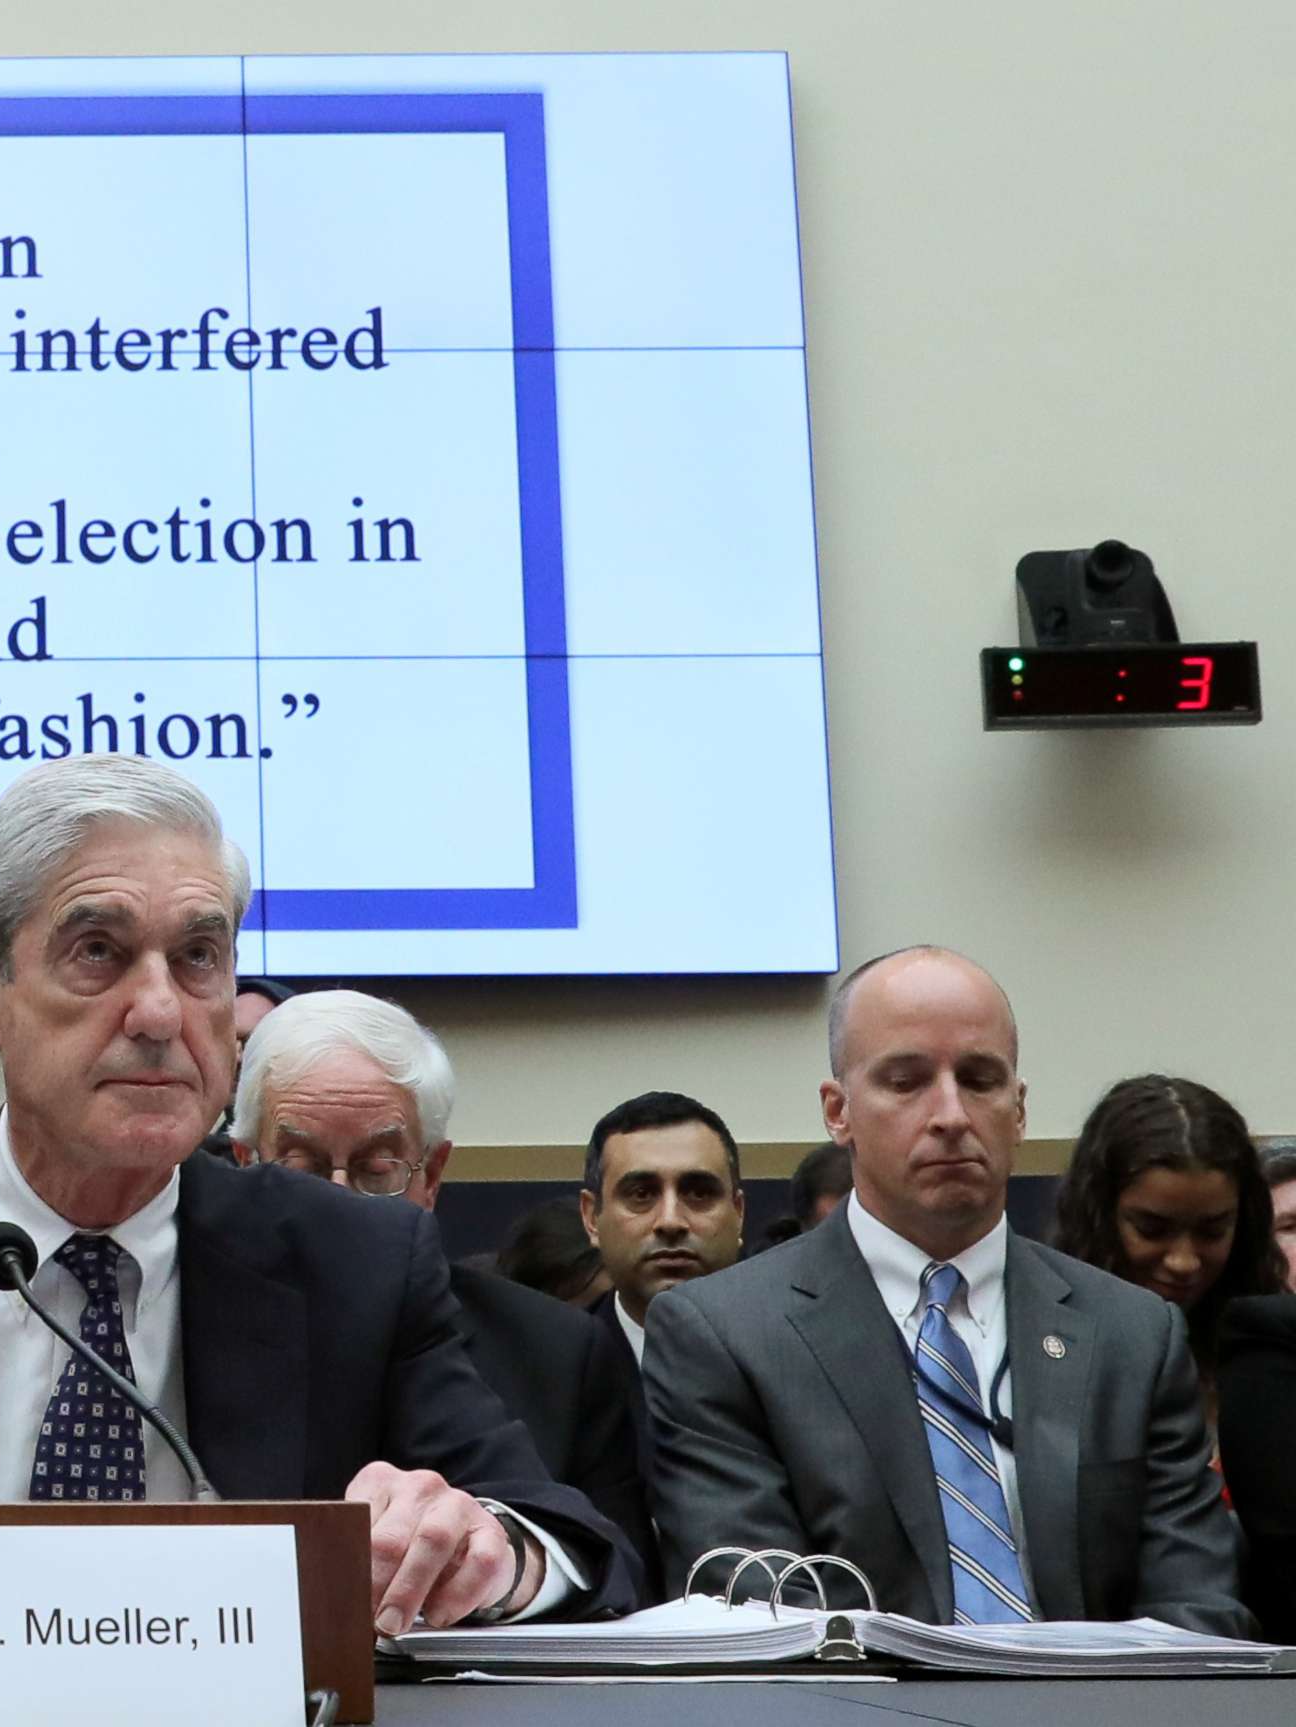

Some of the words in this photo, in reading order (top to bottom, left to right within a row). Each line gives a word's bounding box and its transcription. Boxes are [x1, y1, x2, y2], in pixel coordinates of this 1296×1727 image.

[11, 306, 389, 372] interfered
[6, 498, 317, 565] election
[348, 497, 420, 562] in
[1176, 656, 1214, 710] 3
[25, 1607, 200, 1650] Mueller,
[218, 1607, 255, 1644] III
